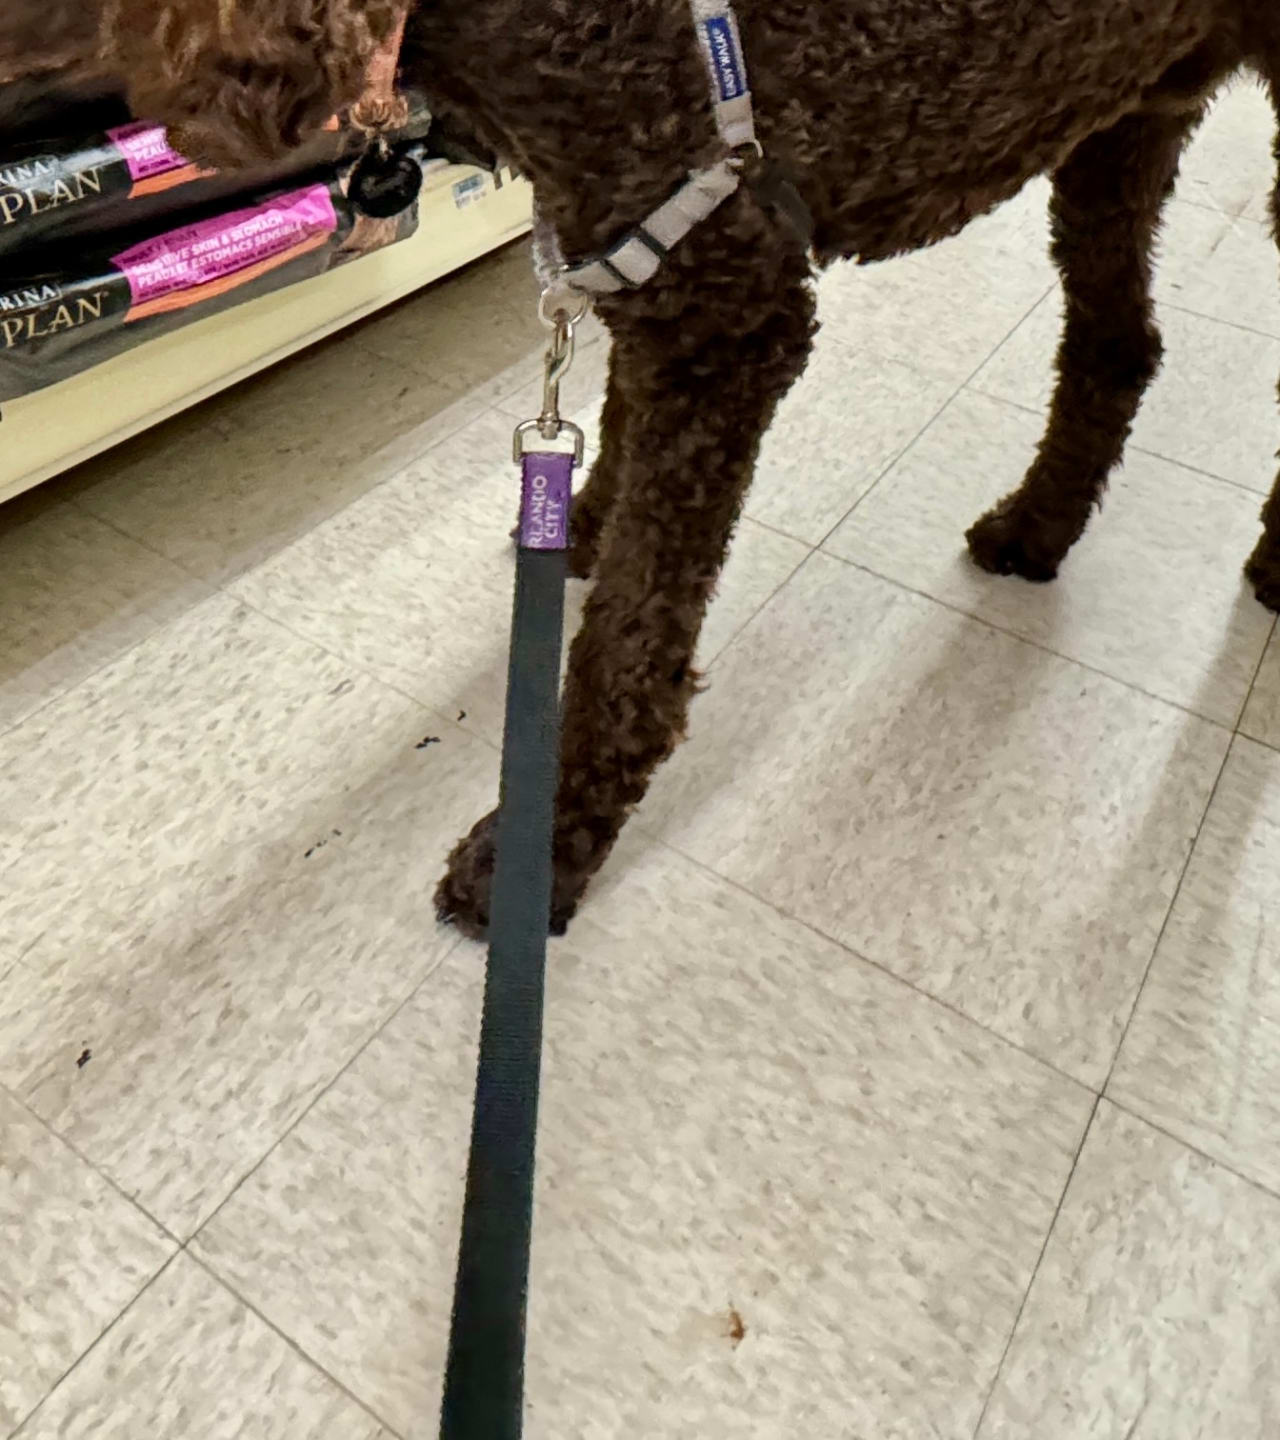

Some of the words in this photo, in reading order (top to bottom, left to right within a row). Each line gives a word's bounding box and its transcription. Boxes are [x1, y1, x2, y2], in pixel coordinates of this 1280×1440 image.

[714, 32, 731, 67] WALK
[0, 291, 104, 349] PLAN
[528, 475, 548, 548] RLANDO
[544, 499, 562, 539] CITY
